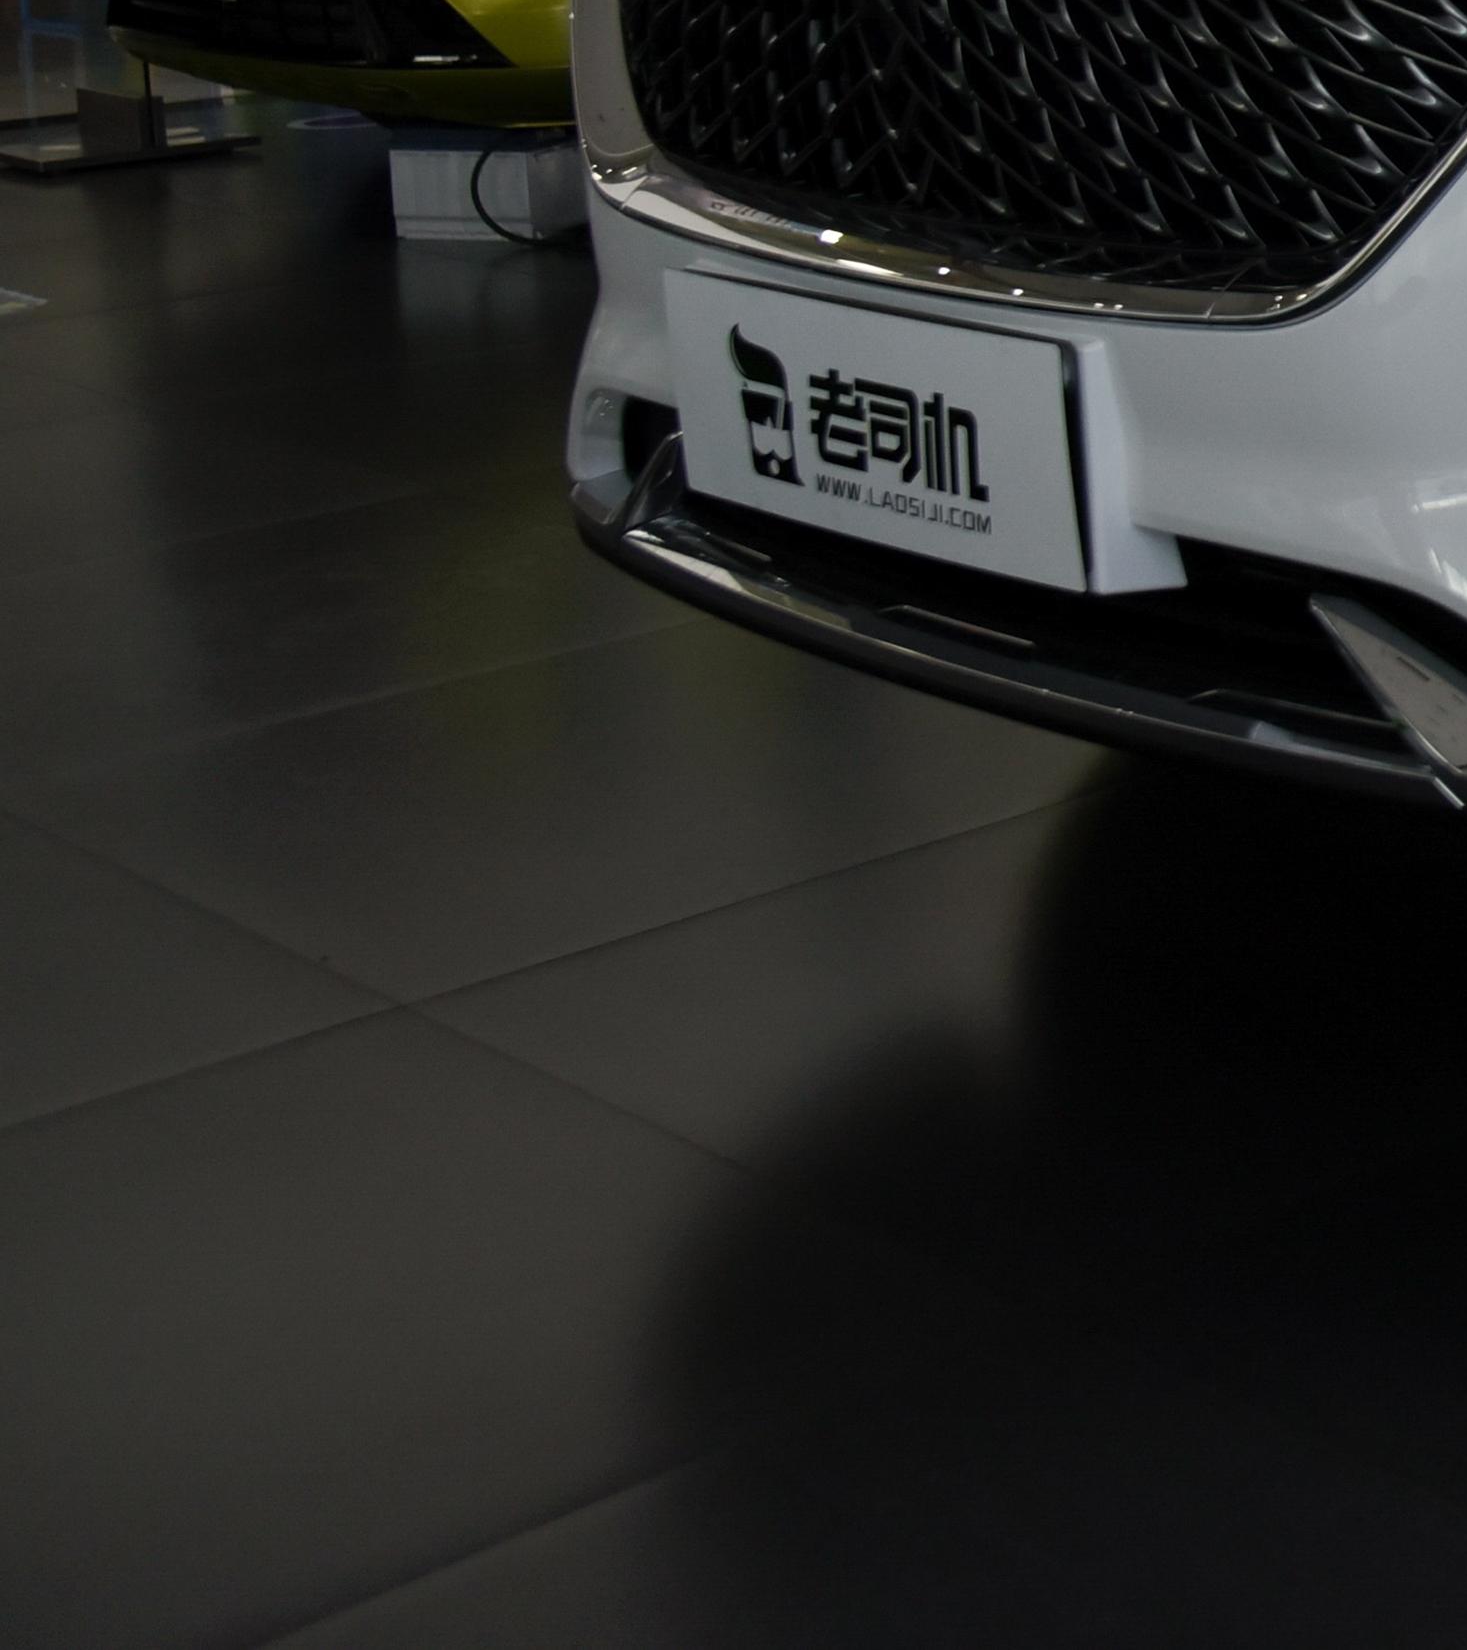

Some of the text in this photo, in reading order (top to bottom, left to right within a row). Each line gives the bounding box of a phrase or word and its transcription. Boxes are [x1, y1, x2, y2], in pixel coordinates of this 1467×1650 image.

[808, 368, 990, 502] 老司机
[815, 473, 993, 536] WWW.LAOSIJI.COM
